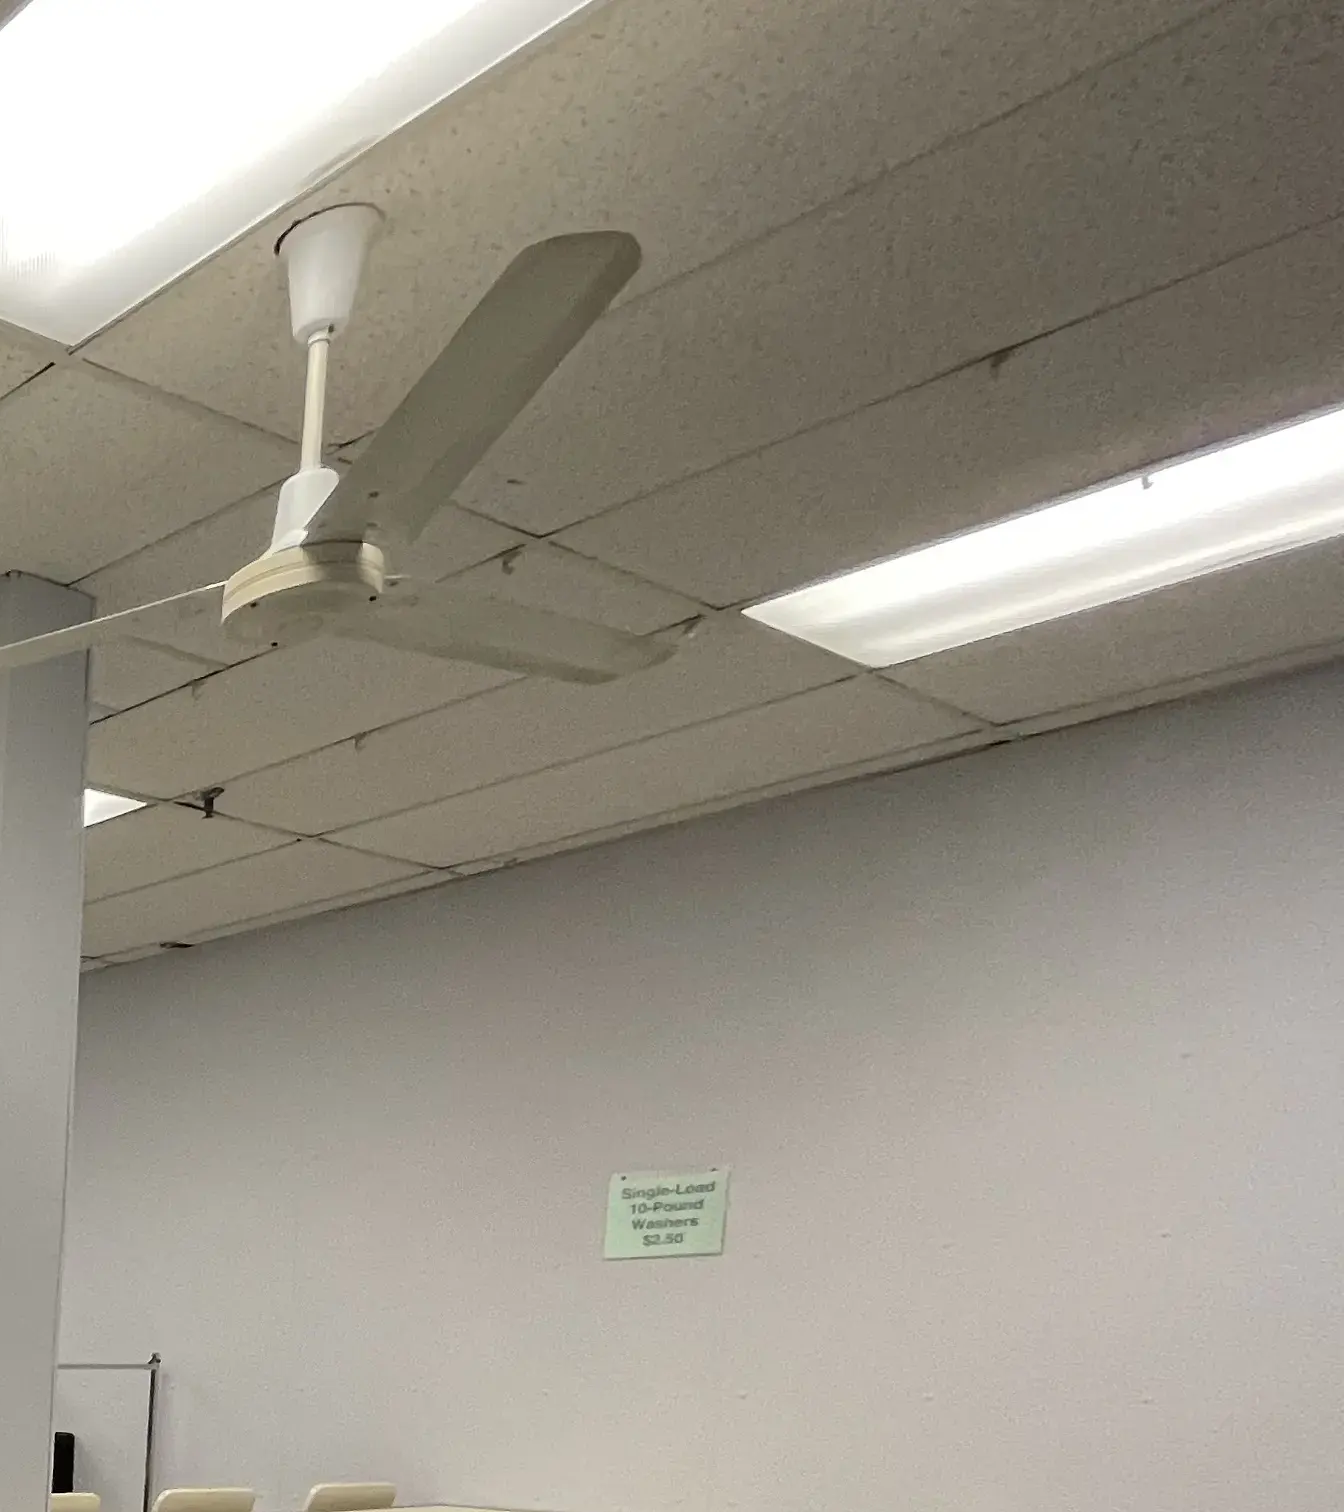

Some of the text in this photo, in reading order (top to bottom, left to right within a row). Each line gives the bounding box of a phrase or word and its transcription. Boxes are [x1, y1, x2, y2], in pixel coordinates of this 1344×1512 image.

[621, 1181, 716, 1200] Single-Load
[630, 1199, 705, 1214] 10-Pound
[631, 1217, 699, 1230] Washers
